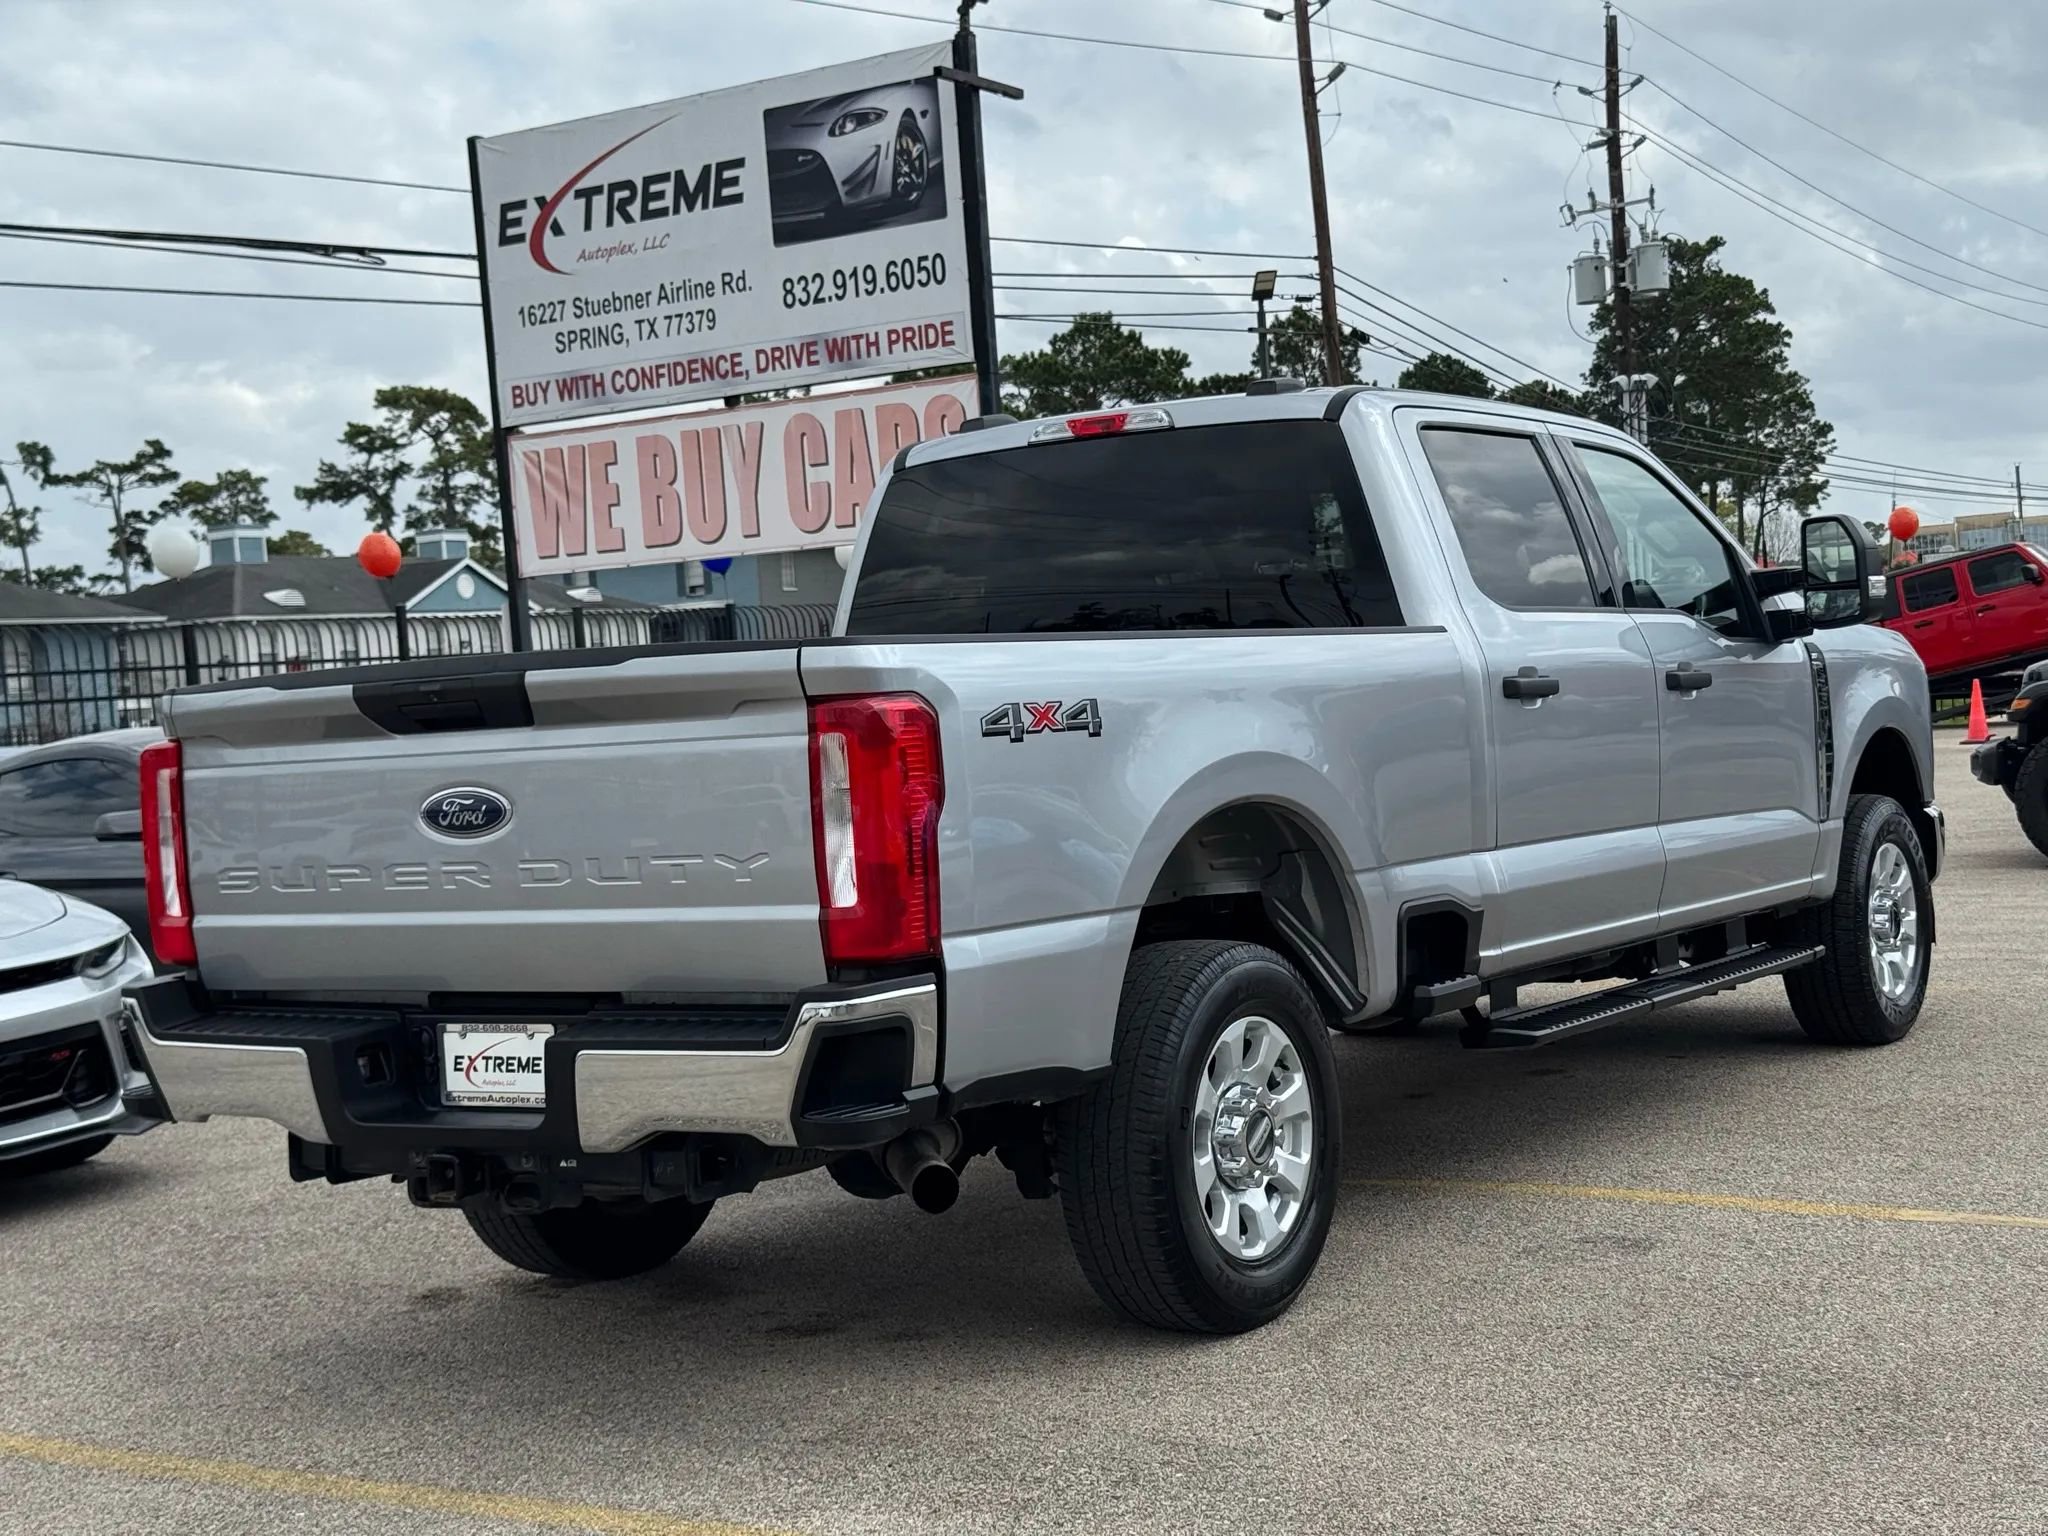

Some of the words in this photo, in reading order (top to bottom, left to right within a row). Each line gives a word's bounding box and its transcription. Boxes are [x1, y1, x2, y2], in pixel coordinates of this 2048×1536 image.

[498, 156, 746, 248] EXTREME
[576, 238, 638, 264] Autoplex,
[642, 232, 672, 253] LLC
[518, 300, 567, 328] 16227
[572, 290, 652, 320] Stuebner
[656, 277, 716, 307] Airline
[721, 269, 752, 296] Rd.
[782, 252, 947, 309] 832.919.6050
[555, 322, 630, 354] SPRING,
[635, 316, 660, 342] TX
[664, 308, 717, 338] 77379
[511, 380, 551, 409] BUY
[555, 372, 606, 402] WITH
[611, 352, 750, 395] CONFIDENCE,
[755, 339, 820, 375] DRIVE
[824, 331, 881, 364] WITH
[887, 319, 956, 355] PRIDE
[522, 439, 626, 559] WE
[635, 420, 765, 549] BUY
[438, 798, 488, 826] Ford
[217, 860, 492, 893] SUPER
[517, 851, 770, 887] DUTY
[453, 1055, 543, 1074] EXTREME
[445, 1094, 546, 1105] ExtremeAutoplex.co
